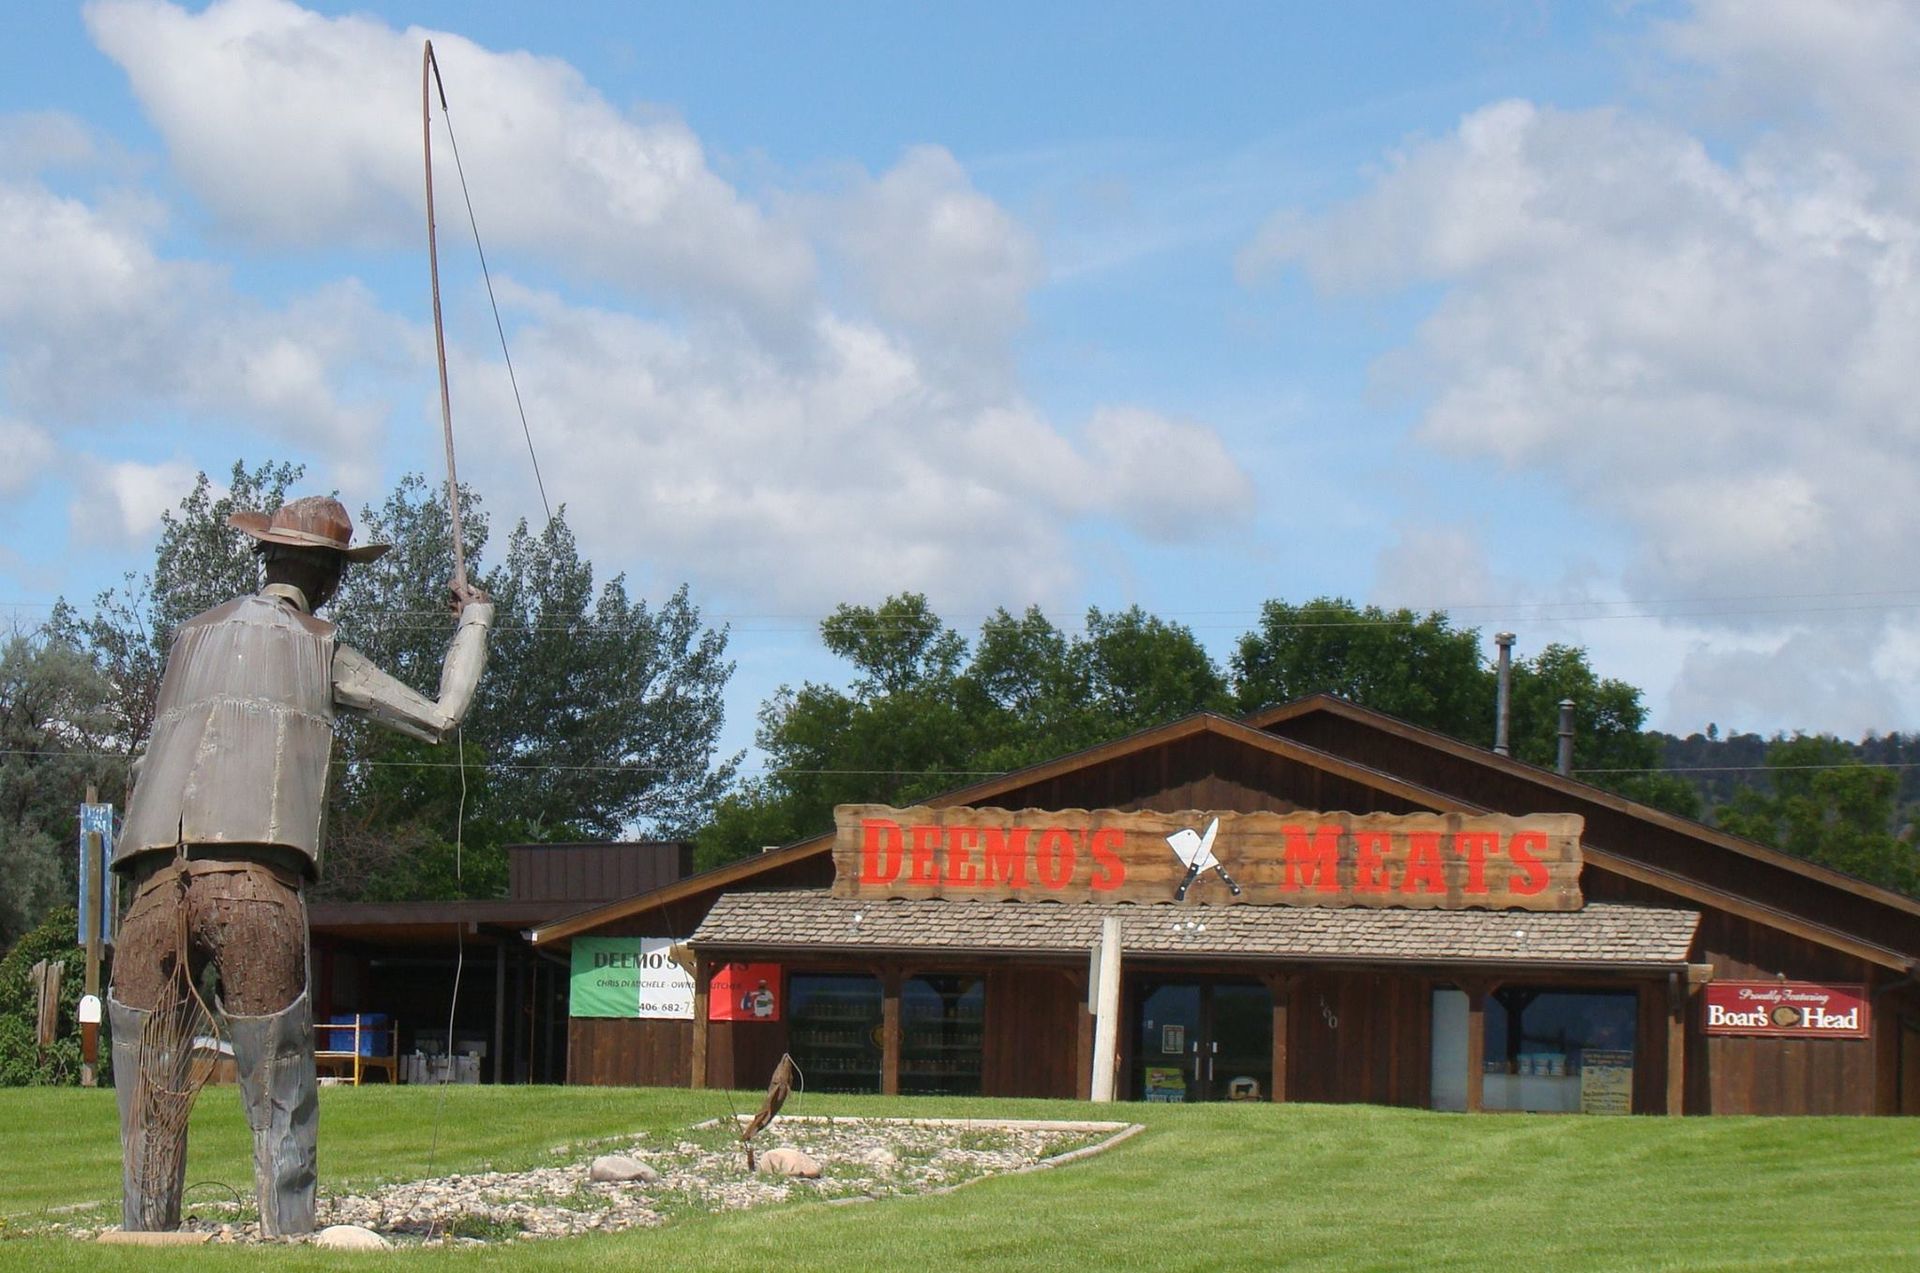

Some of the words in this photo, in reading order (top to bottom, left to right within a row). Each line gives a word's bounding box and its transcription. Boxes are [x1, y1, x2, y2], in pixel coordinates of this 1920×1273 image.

[859, 818, 1128, 891] DEEMO'S
[1279, 824, 1550, 895] MEATS
[593, 953, 678, 970] DEEMO'S
[597, 979, 620, 988] CHRIS
[671, 981, 696, 989] OWNE
[637, 1001, 696, 1015] 406-682-7
[1708, 1005, 1769, 1027] Boar's
[1802, 1007, 1858, 1029] Head
